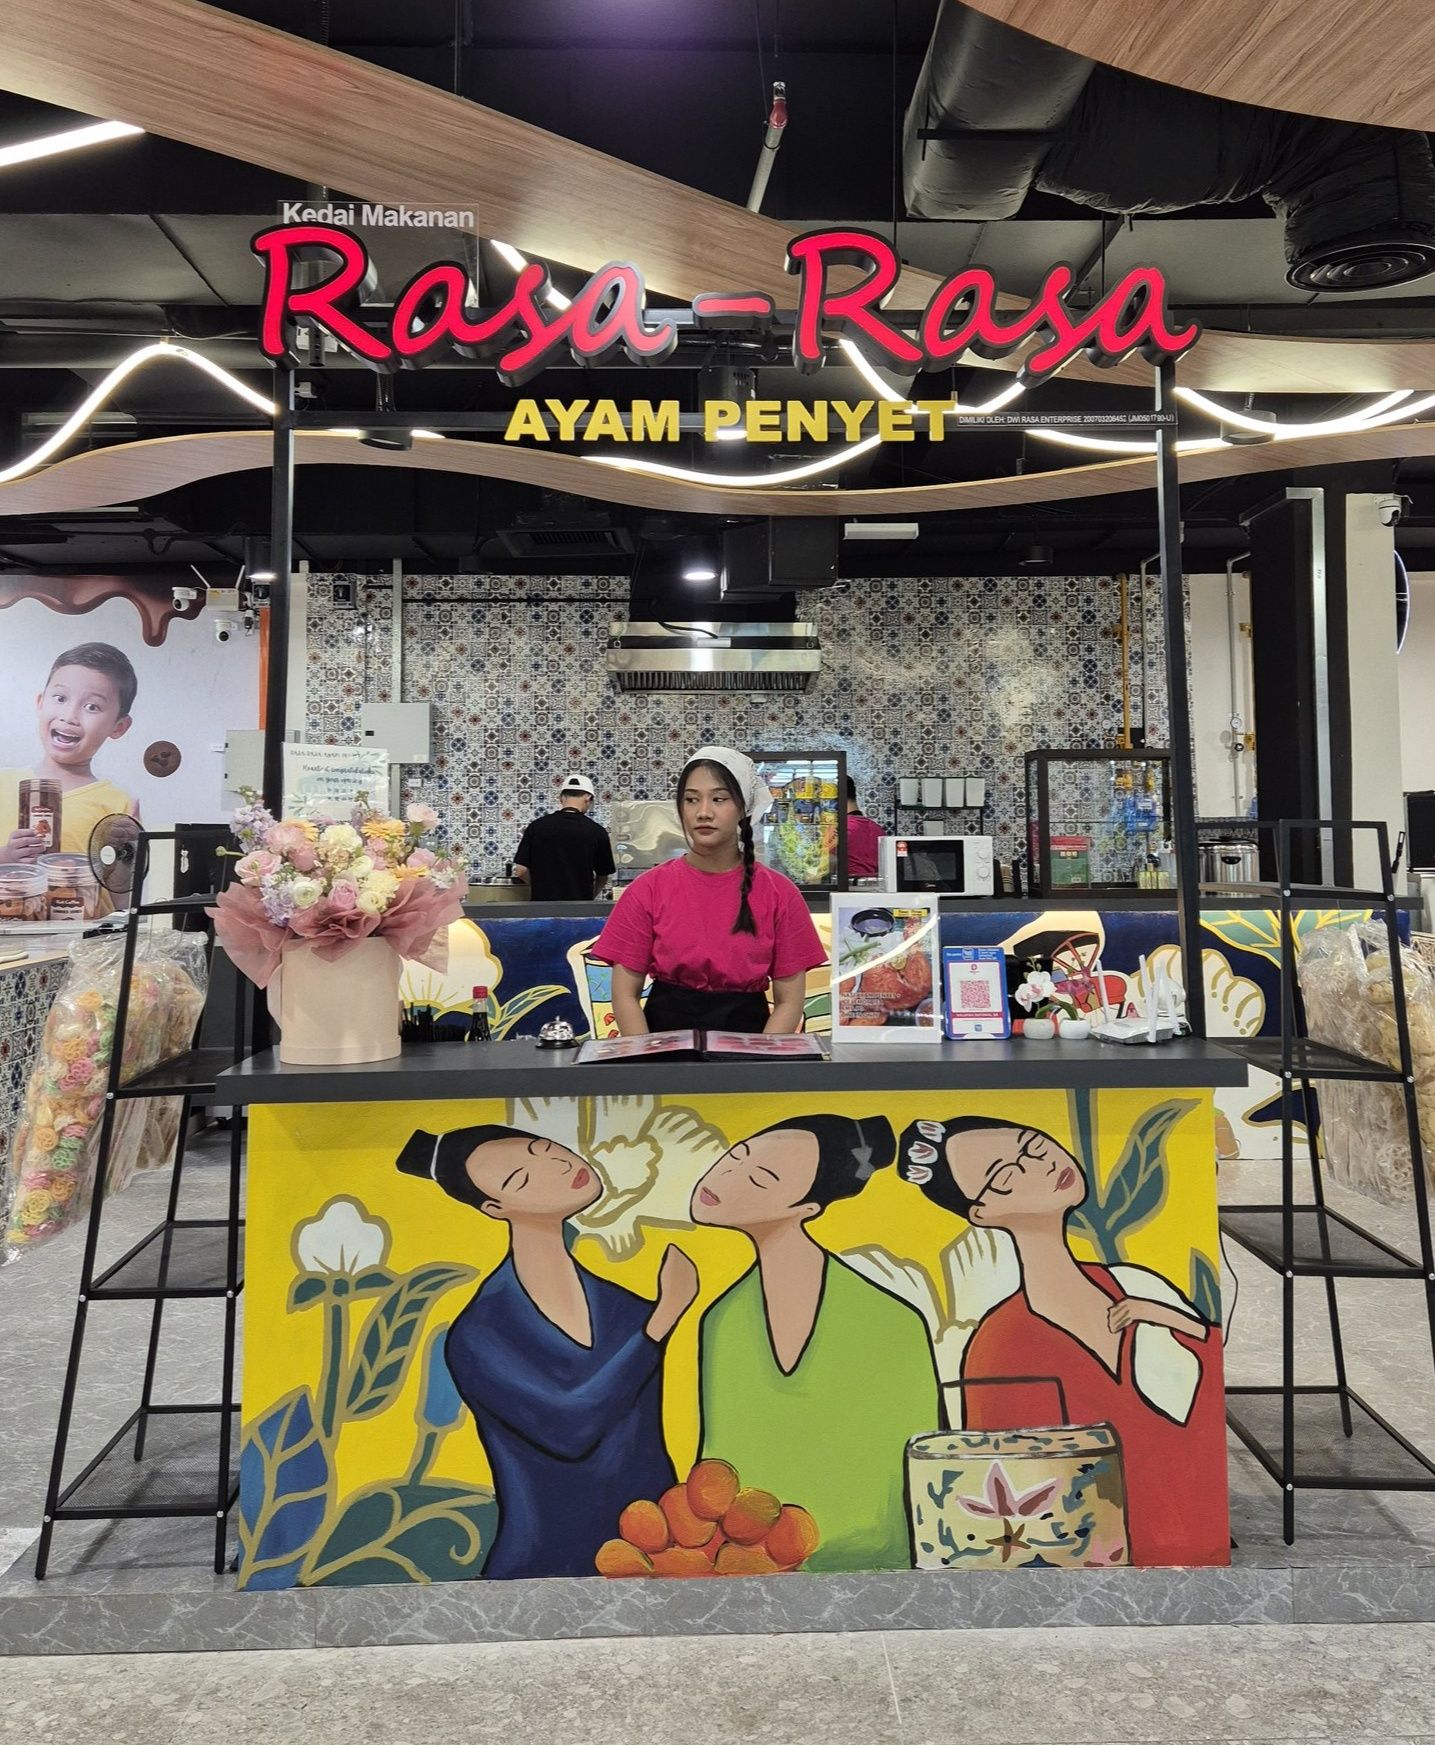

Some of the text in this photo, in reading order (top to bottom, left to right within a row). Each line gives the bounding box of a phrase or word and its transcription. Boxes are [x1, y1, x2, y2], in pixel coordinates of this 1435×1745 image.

[282, 203, 475, 228] Kedai Makanan
[504, 399, 956, 442] AYAM PENYET
[1007, 416, 1020, 424] DWI
[1021, 415, 1039, 424] RASA
[1040, 415, 1082, 424] ENTERPRISE
